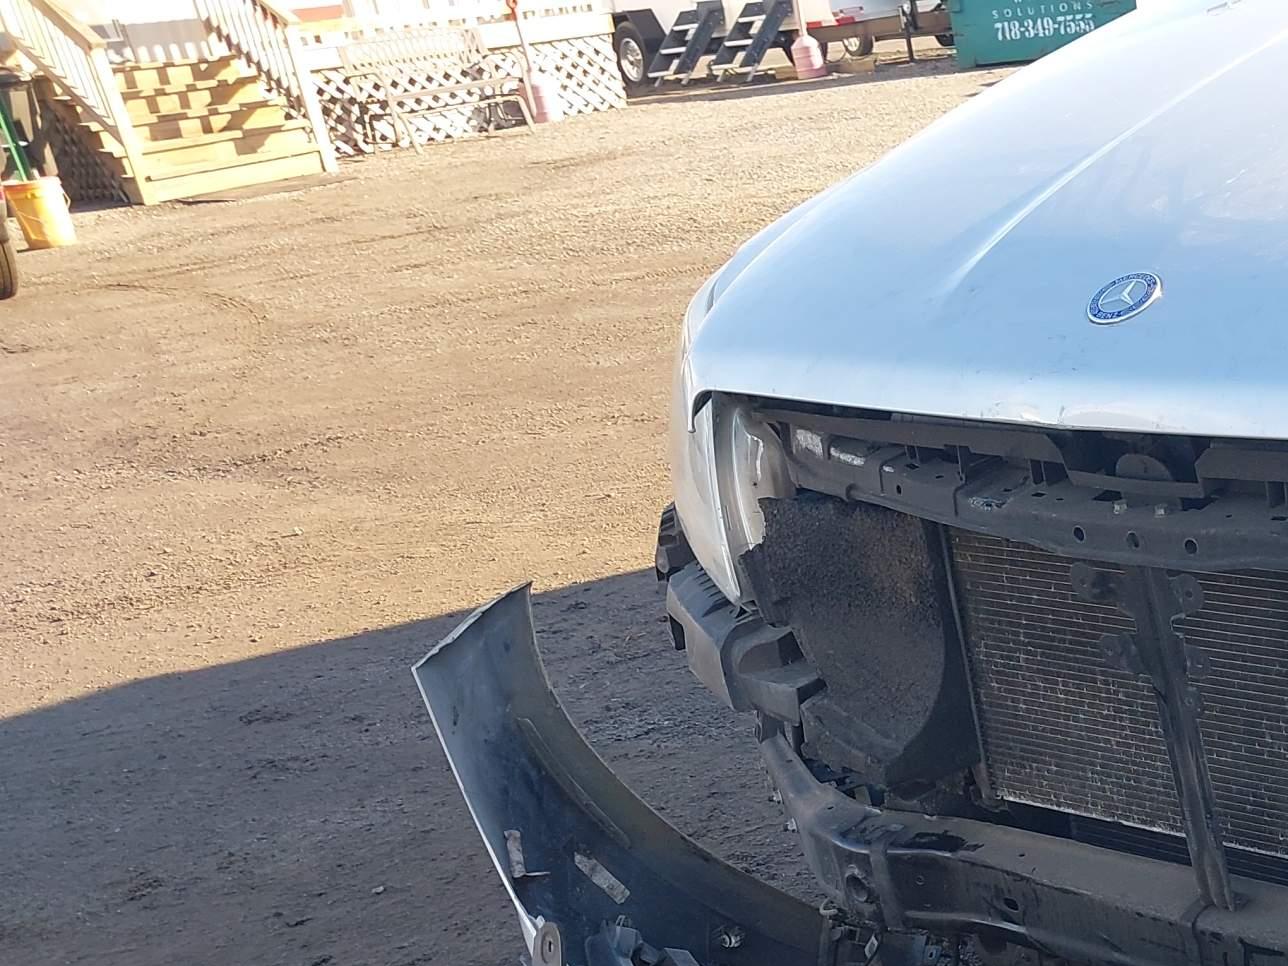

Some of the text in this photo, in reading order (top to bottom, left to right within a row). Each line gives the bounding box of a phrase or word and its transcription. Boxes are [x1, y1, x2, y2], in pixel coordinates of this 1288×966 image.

[991, 1, 1093, 19] SOLUTIONS
[994, 13, 1095, 41] 718-349-7555
[1096, 310, 1118, 320] BENZ
